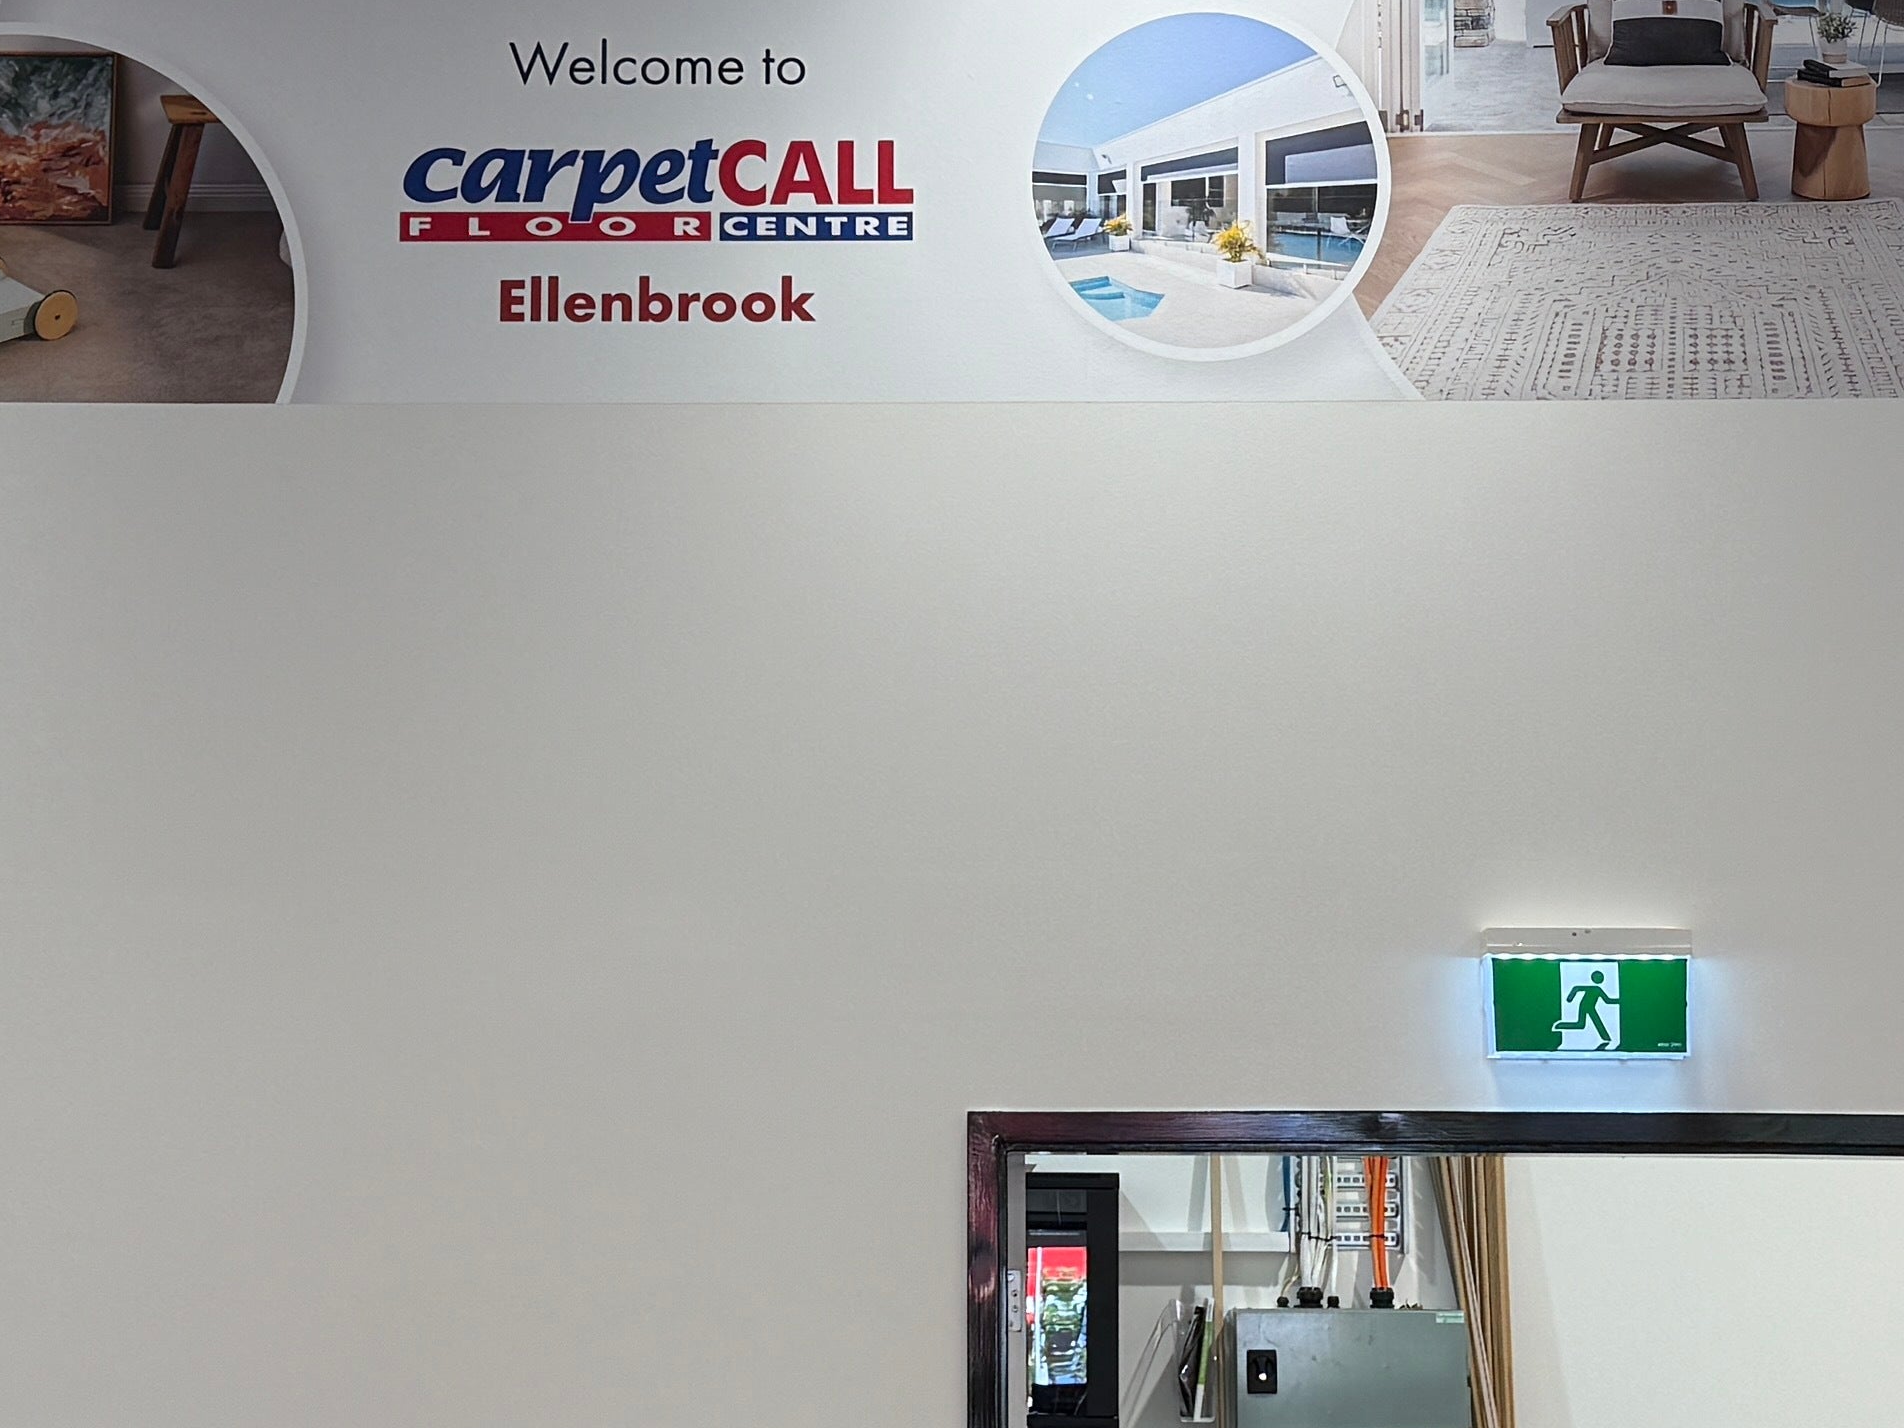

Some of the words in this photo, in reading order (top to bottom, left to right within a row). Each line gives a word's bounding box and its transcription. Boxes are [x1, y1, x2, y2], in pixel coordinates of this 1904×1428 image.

[509, 39, 744, 86] Welcome
[761, 48, 807, 86] to
[409, 215, 702, 237] FLOOR
[723, 215, 910, 238] CENTRE
[499, 275, 816, 324] Ellenbrook
